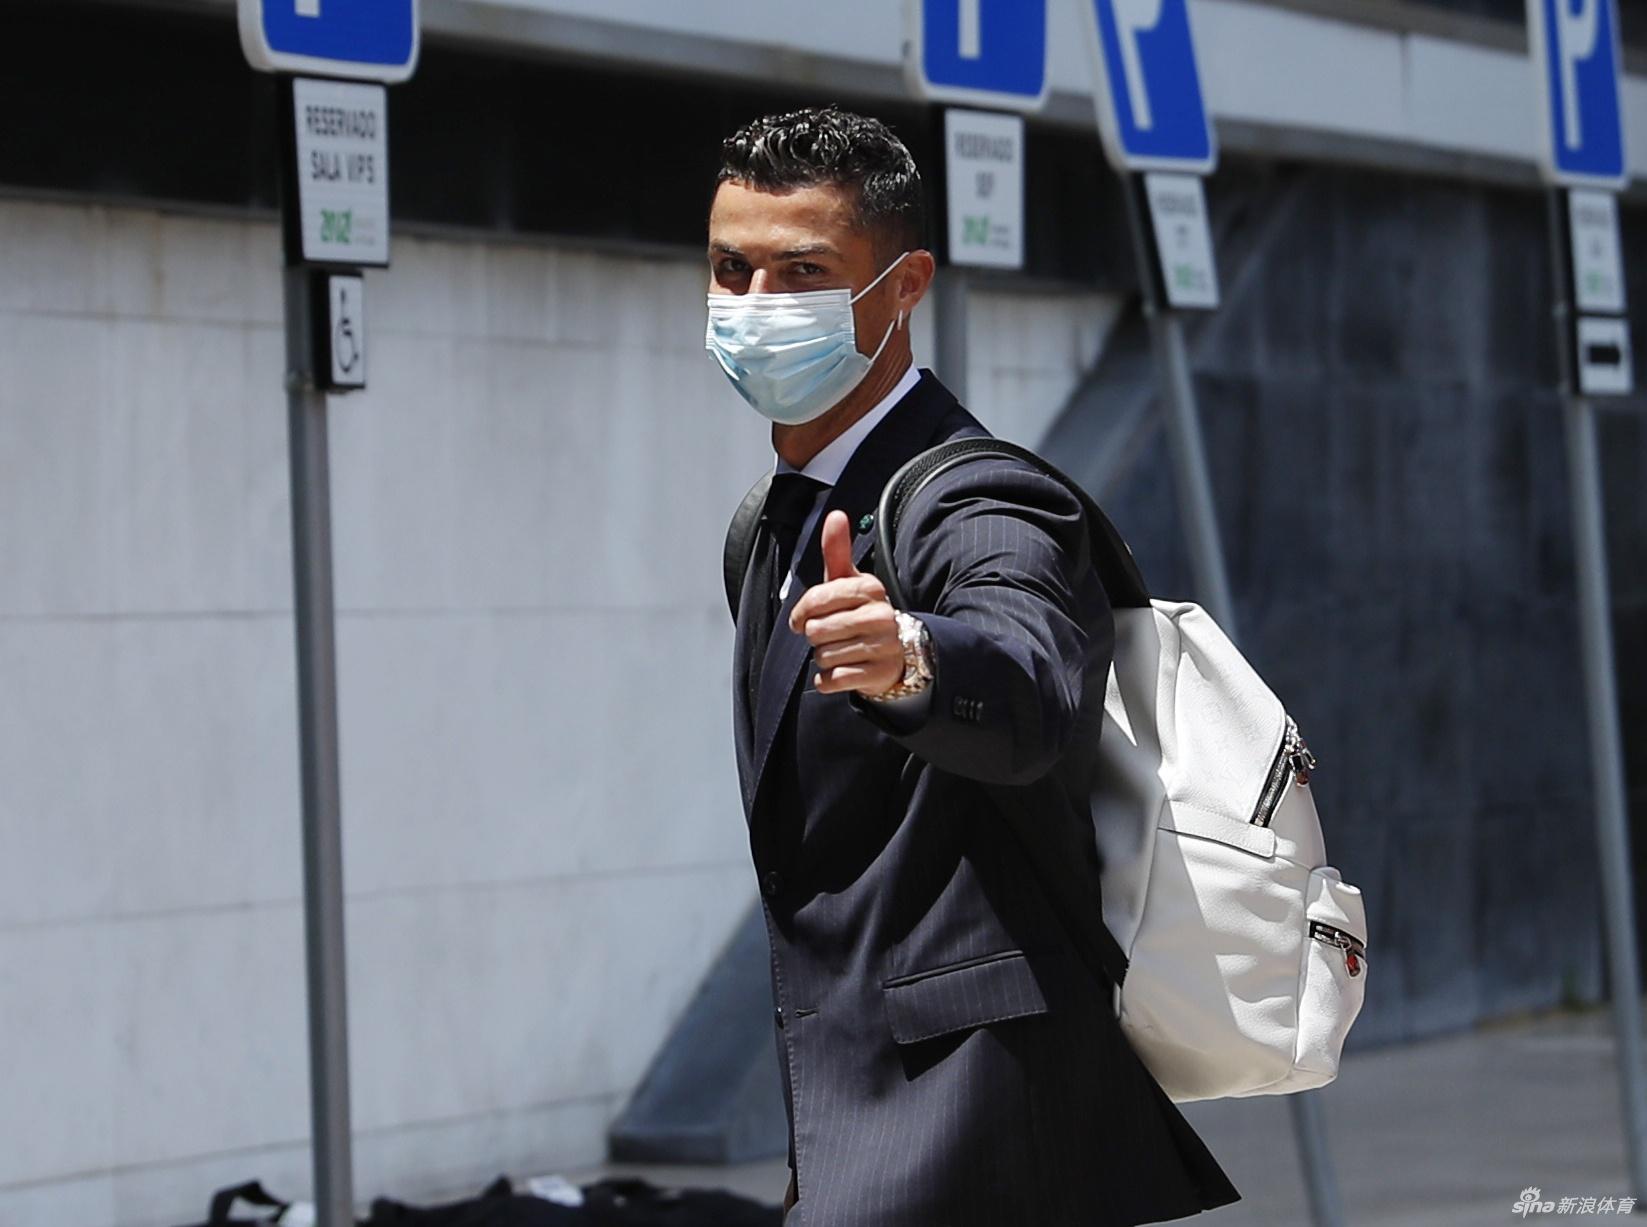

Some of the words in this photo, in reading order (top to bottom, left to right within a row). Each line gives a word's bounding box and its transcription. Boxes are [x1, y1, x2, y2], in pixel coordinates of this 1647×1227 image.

[305, 104, 376, 140] RESERVADO
[311, 150, 341, 181] SALA
[347, 154, 375, 184] VIPS
